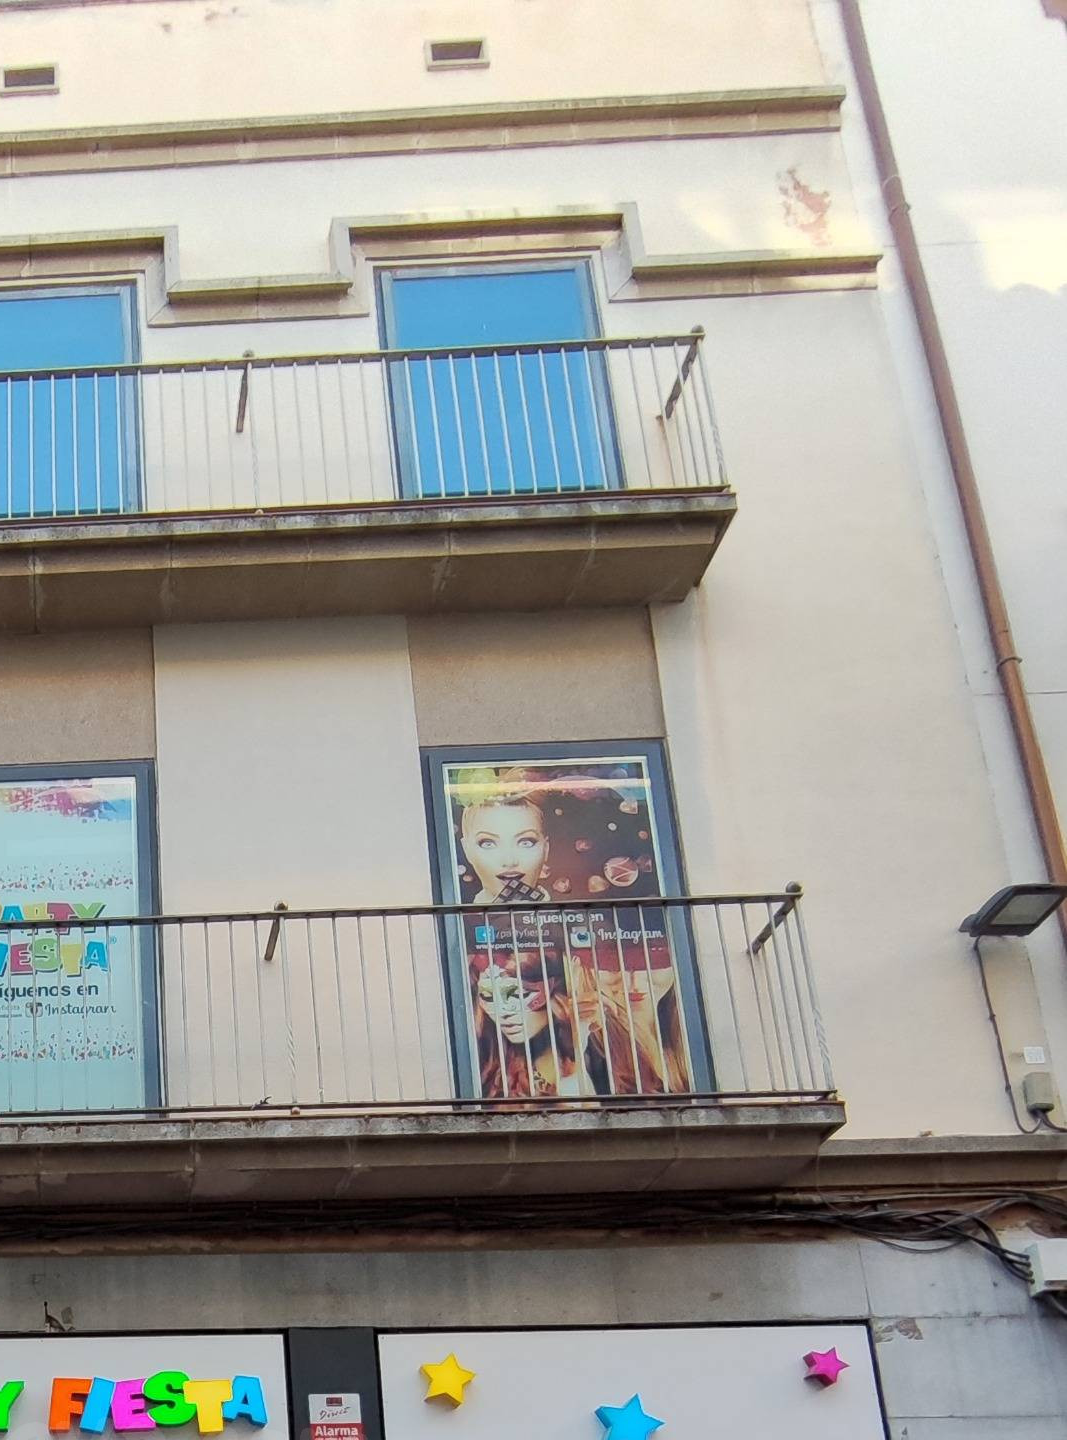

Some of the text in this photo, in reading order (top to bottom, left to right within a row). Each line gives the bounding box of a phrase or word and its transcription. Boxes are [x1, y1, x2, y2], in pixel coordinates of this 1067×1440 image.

[77, 984, 99, 996] en
[48, 1370, 268, 1435] FIESTA
[315, 1426, 359, 1436] Alarma
